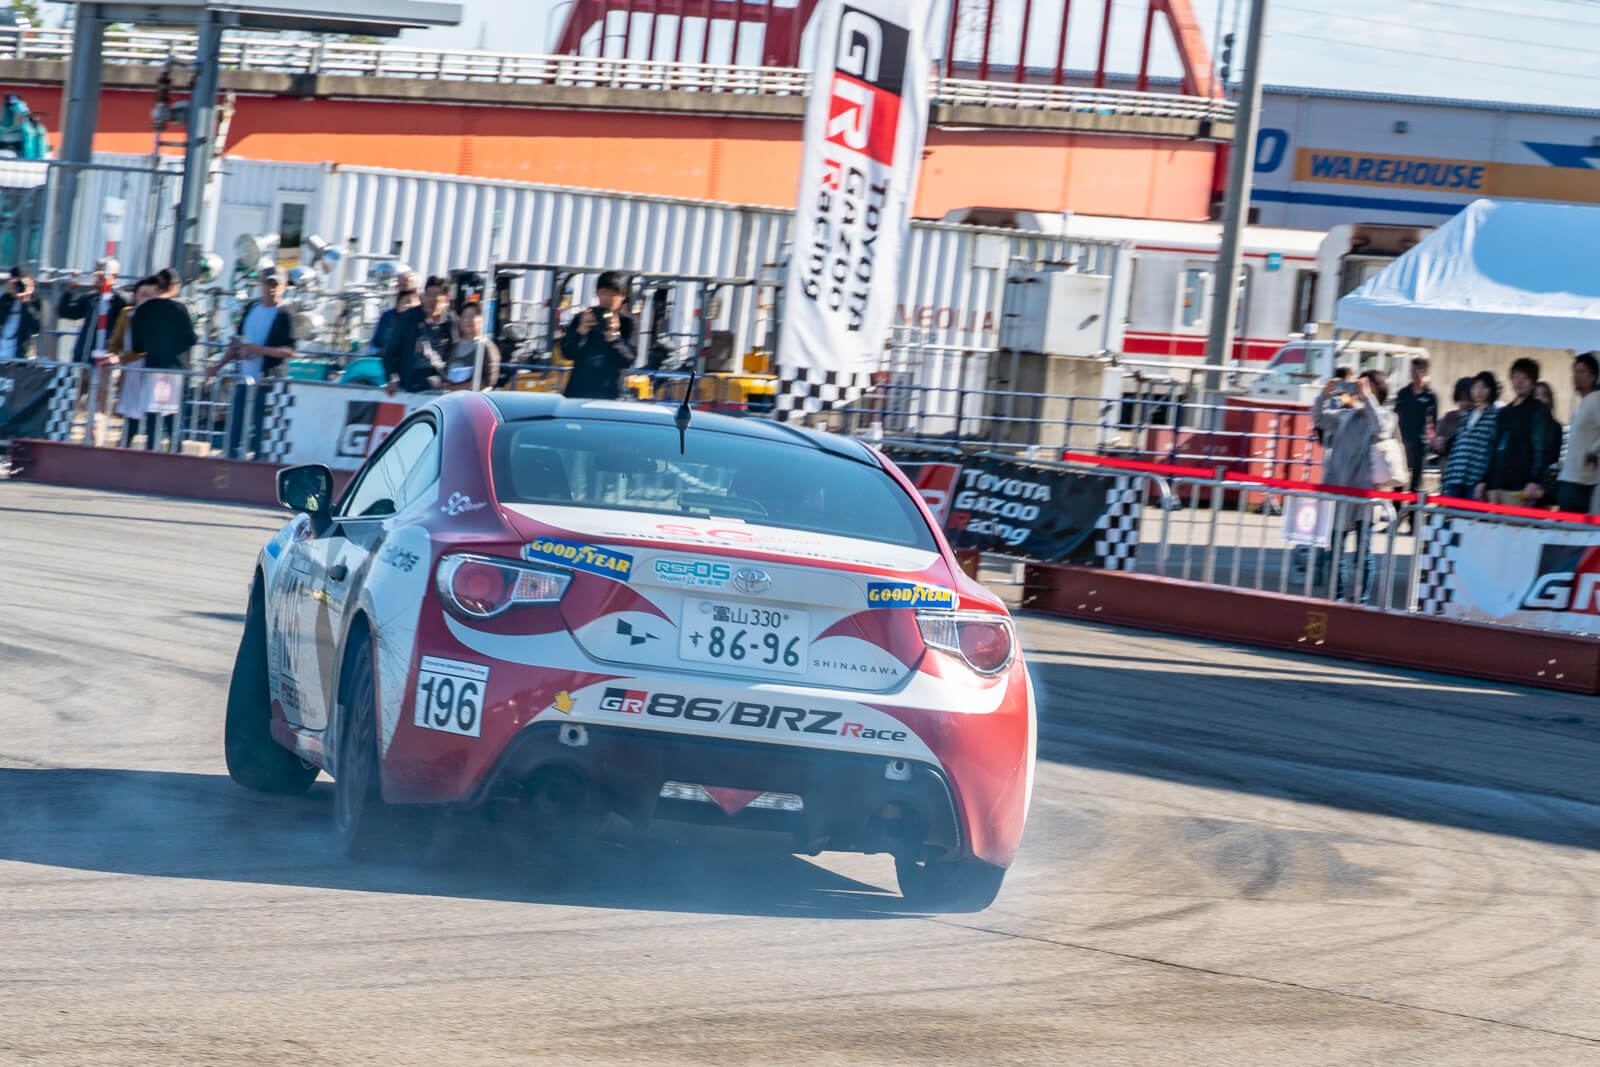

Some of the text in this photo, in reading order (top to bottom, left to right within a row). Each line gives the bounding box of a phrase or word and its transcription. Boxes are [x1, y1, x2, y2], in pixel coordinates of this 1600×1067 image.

[829, 10, 883, 150] GR
[1310, 153, 1486, 190] WAREHOUSE
[801, 158, 842, 301] Racing
[829, 166, 865, 312] GAZOO
[848, 178, 890, 331] TOYOTA
[897, 303, 998, 336] VEOLIA
[962, 468, 1052, 502] TOYOTA
[954, 490, 1041, 522] GAZOO
[947, 511, 1032, 546] Racing
[531, 539, 631, 574] GOODYEAR
[868, 584, 951, 606] GOODYEAR
[812, 659, 899, 677] SHINAGAWA
[421, 675, 479, 731] 196
[600, 696, 644, 714] GR
